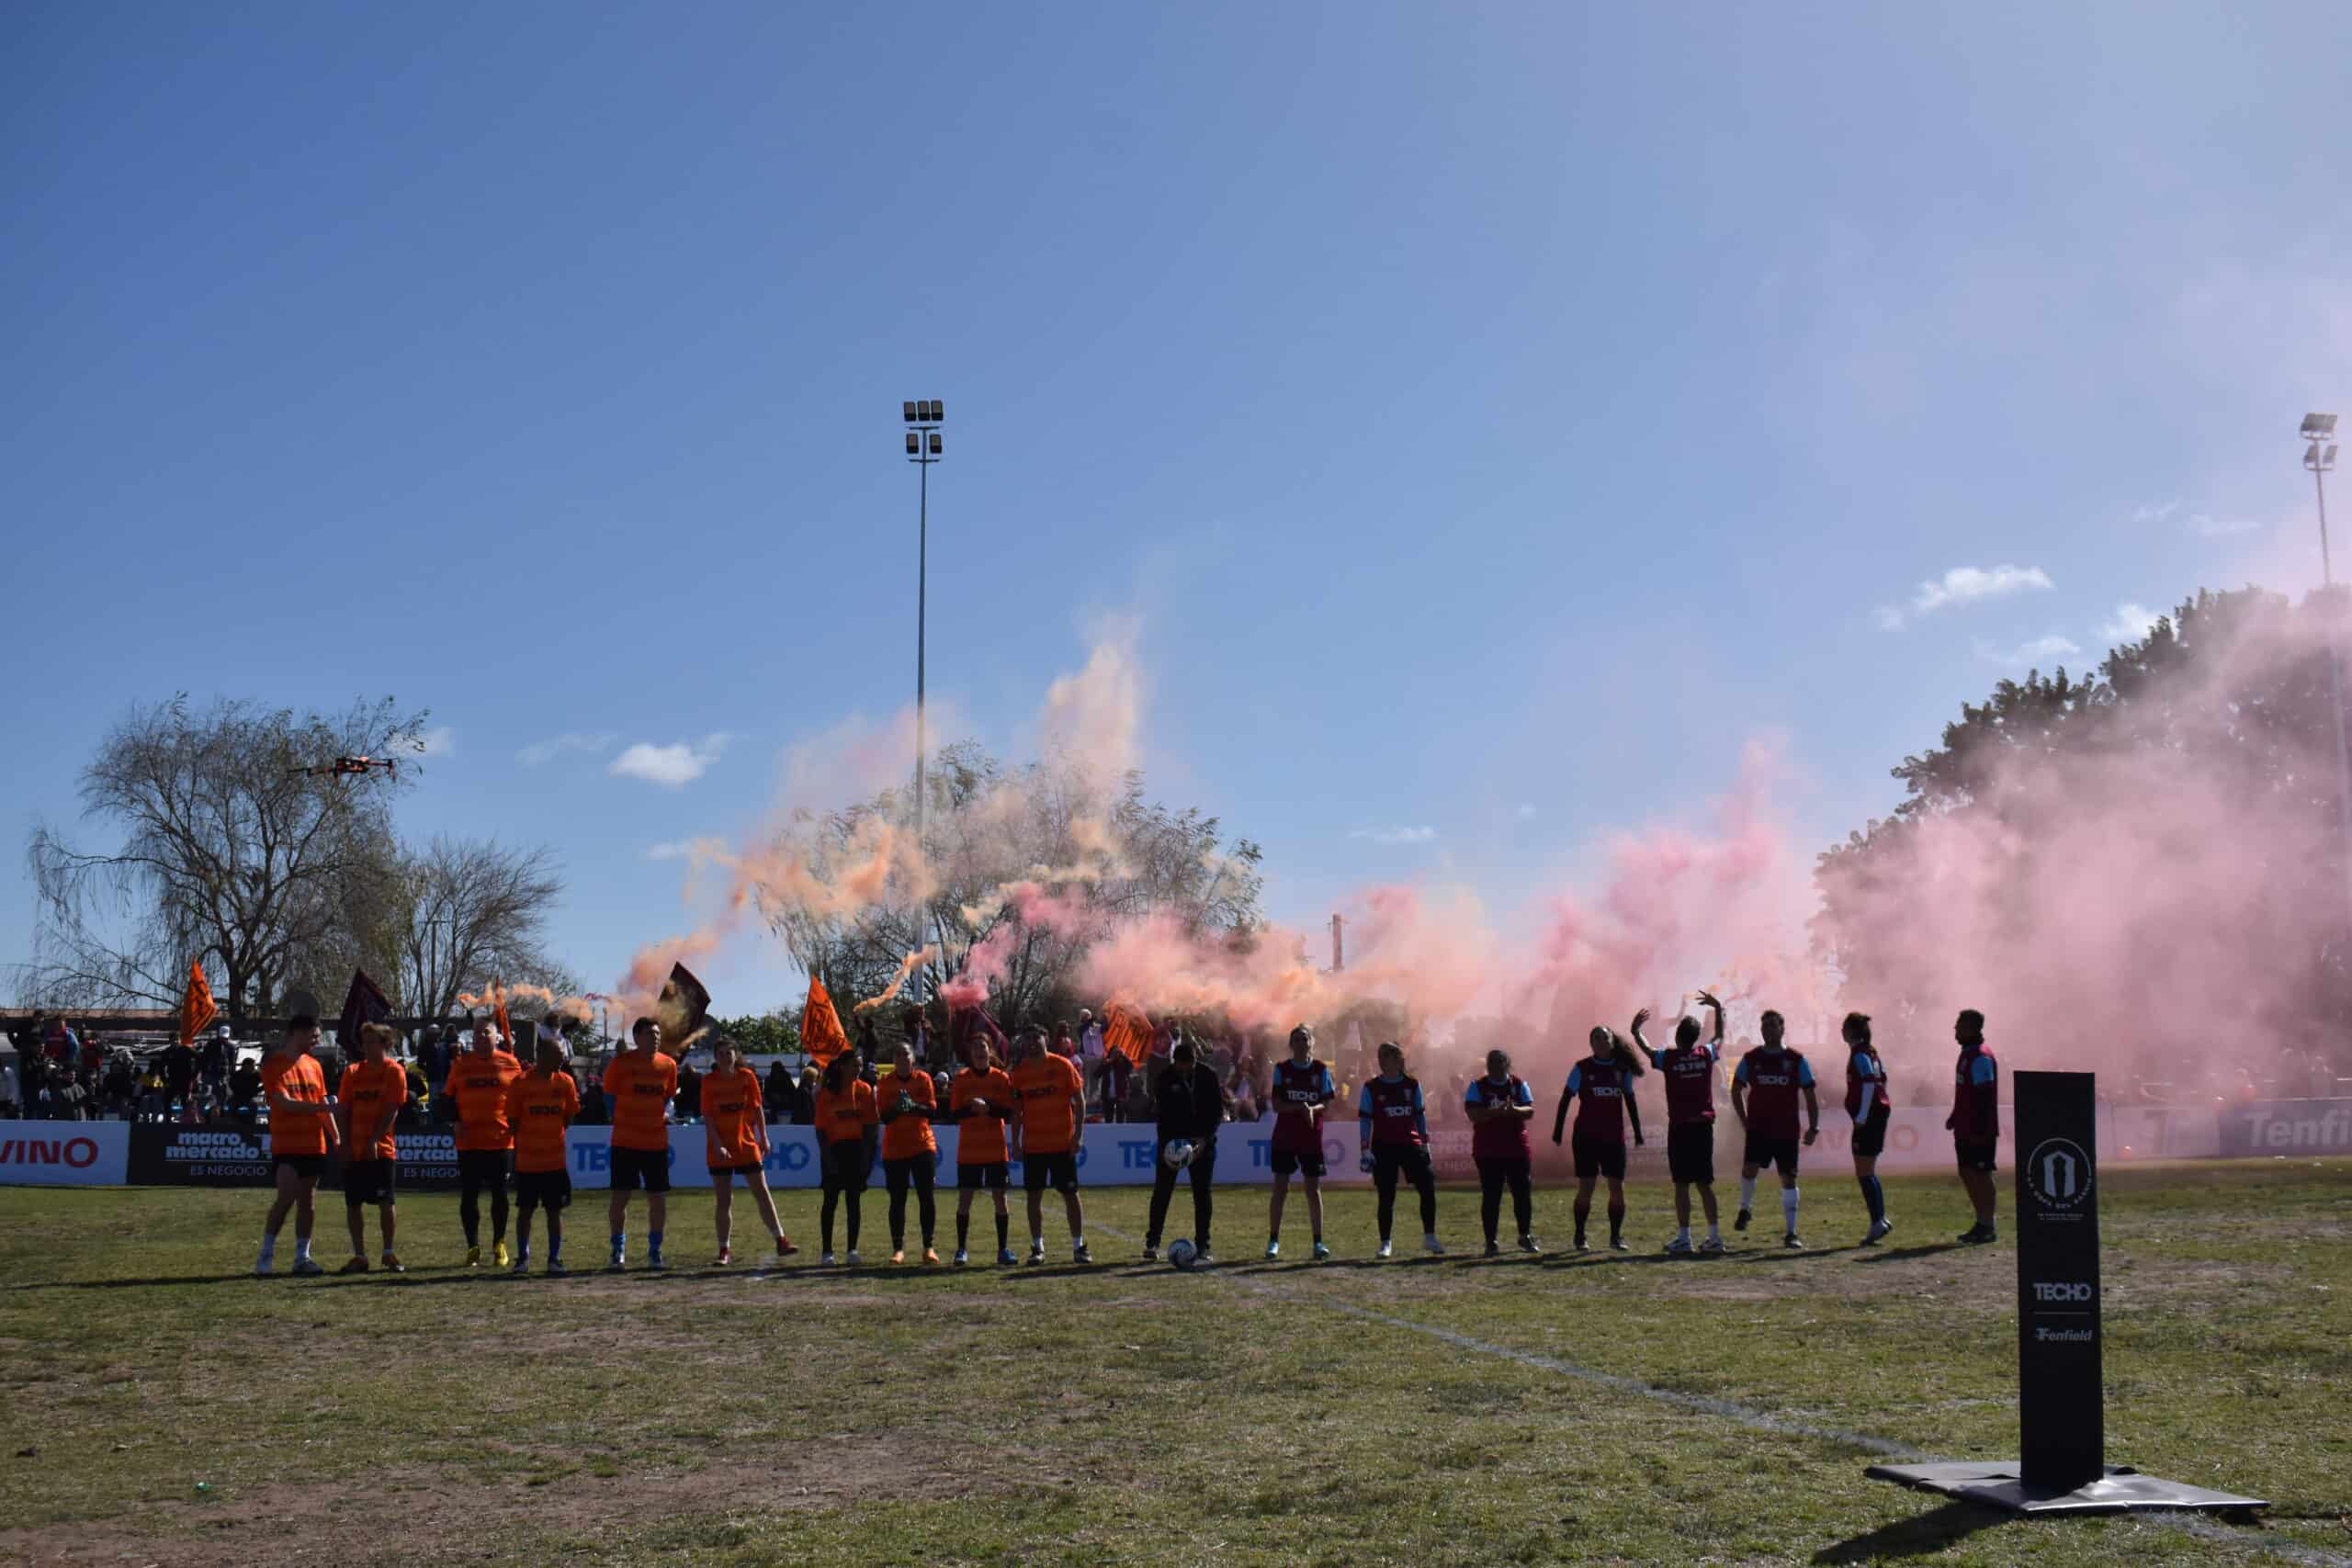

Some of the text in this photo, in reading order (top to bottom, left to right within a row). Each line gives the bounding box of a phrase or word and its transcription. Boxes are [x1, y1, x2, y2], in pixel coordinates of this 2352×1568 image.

[1286, 1090, 1317, 1101] TECHO
[2244, 1110, 2352, 1147] Tenfi
[177, 1132, 241, 1145] macro
[395, 1134, 455, 1147] macro
[165, 1142, 260, 1158] mercado
[396, 1145, 458, 1161] ercad
[190, 1165, 267, 1176] ES NEGOCIO
[404, 1168, 418, 1177] ES
[2032, 1282, 2092, 1301] TECHO
